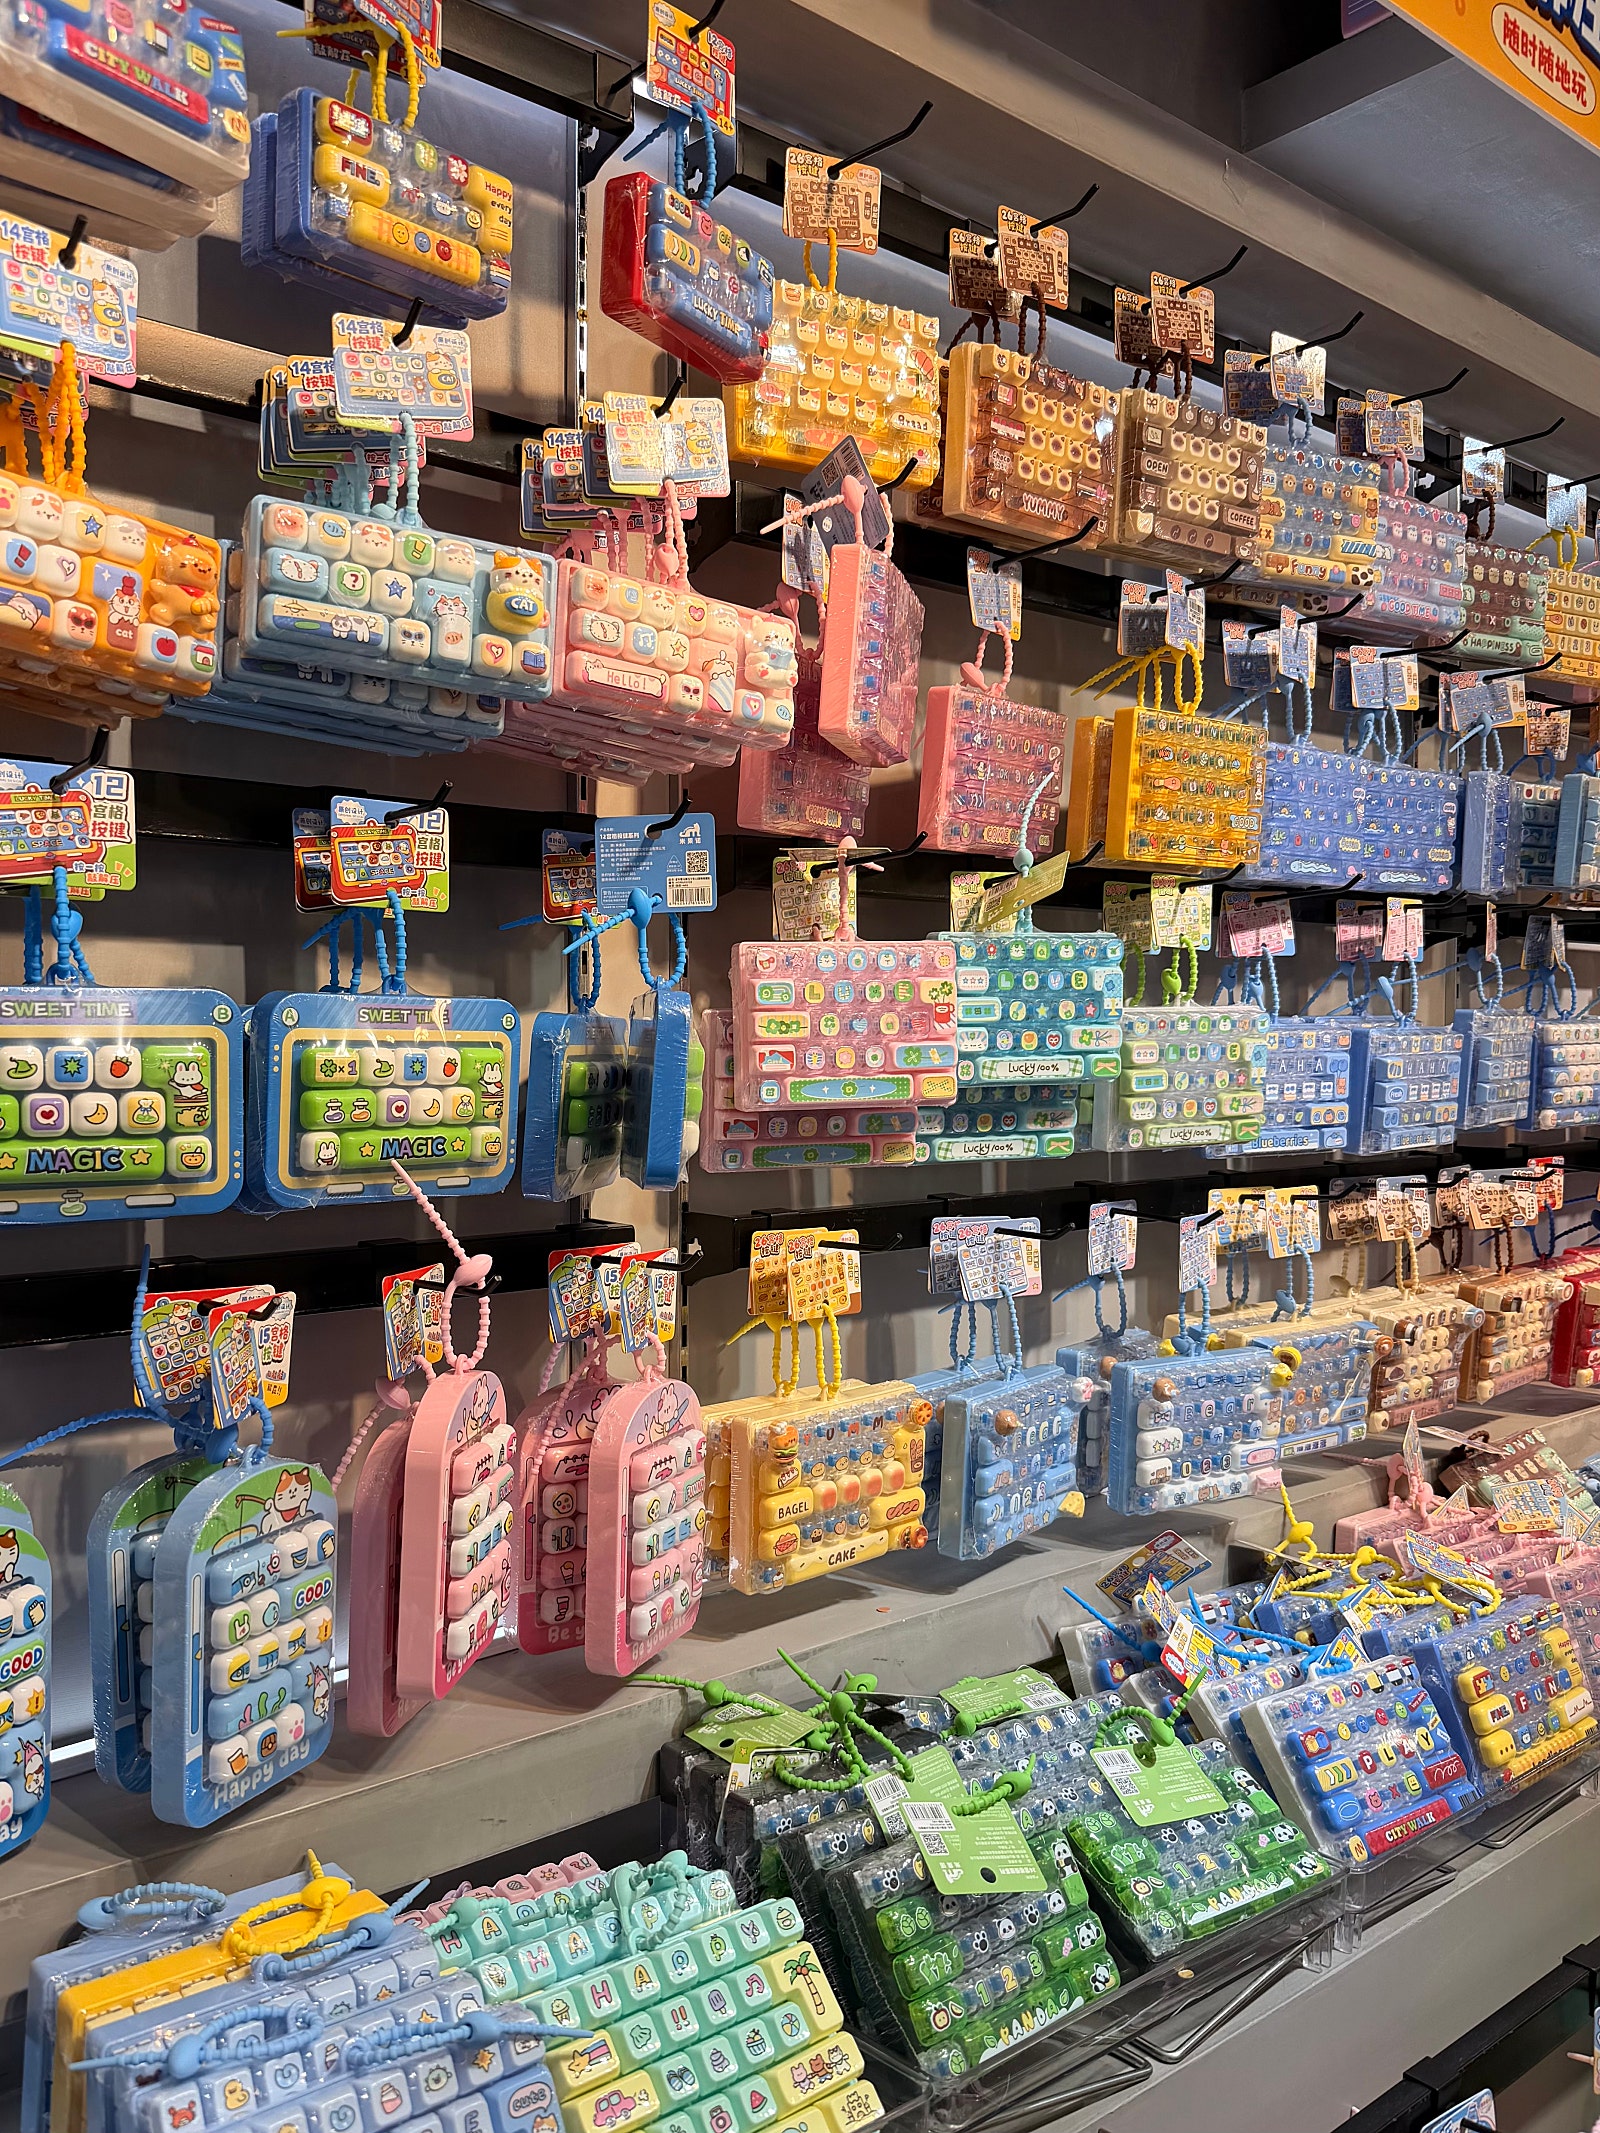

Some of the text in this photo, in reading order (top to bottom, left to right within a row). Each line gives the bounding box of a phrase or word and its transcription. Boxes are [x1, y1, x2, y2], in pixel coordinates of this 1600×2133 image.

[423, 46, 440, 64] 14+
[1503, 12, 1587, 107] 随时随地玩
[83, 41, 188, 106] CITY WALK
[718, 118, 733, 132] 14+
[789, 152, 823, 168] 26宫格
[797, 165, 819, 178] 按键
[485, 182, 512, 202] Happy
[491, 200, 512, 215] every
[498, 214, 512, 227] day
[1001, 209, 1027, 225] 26宫格
[1, 221, 50, 247] 14宫格
[952, 231, 981, 245] 26宫格
[14, 243, 49, 267] 按键
[106, 309, 121, 321] CAT
[693, 296, 739, 334] LUCKY TIME
[337, 319, 384, 336] 14宫格
[352, 337, 383, 350] 按键
[76, 357, 105, 373] 按一按
[442, 375, 454, 383] CAT
[620, 411, 647, 425] 按键
[898, 414, 928, 431] Bread
[415, 424, 442, 435] 按一按
[1147, 460, 1168, 473] OPEN
[675, 485, 700, 495] 按一按
[1022, 493, 1066, 521] YUMMY
[1230, 512, 1255, 526] COFFEE
[1290, 561, 1327, 579] Funny
[511, 597, 534, 612] CAT
[1389, 601, 1431, 620] GOOD TIME
[115, 627, 134, 640] cat
[1470, 635, 1514, 653] HAPPINESS
[607, 671, 646, 690] Hello!
[91, 774, 126, 798] 12
[92, 803, 124, 820] 宫格
[338, 806, 365, 816] 原创设计
[418, 812, 442, 831] 12
[1233, 816, 1257, 829] GOOD
[90, 821, 126, 841] 按键
[987, 826, 1008, 843] COME
[31, 838, 64, 849] SPACE
[417, 836, 442, 851] 宫格
[73, 861, 106, 873] 按一按
[415, 852, 443, 868] 按键
[86, 873, 121, 886] 敲解压
[402, 888, 426, 897] 按一按
[411, 897, 437, 908] 敲解压
[1, 1001, 132, 1018] SWEET TIME
[217, 1008, 229, 1020] B
[284, 1009, 295, 1021] A
[359, 1008, 411, 1024] SWEET
[505, 1017, 513, 1028] B
[1008, 1062, 1036, 1075] Lucky
[1169, 1128, 1192, 1141] Lucky
[1252, 1134, 1309, 1150] Blueberries
[381, 1137, 447, 1160] MAGIC
[963, 1143, 990, 1157] Lucky
[27, 1149, 125, 1174] MAGIC
[958, 1225, 989, 1239] 26宫格
[754, 1232, 785, 1249] 26宫格
[787, 1235, 815, 1253] 26宫格
[965, 1235, 986, 1247] 按键
[184, 1334, 206, 1348] GOOD
[259, 1323, 290, 1348] 15宫格
[262, 1344, 285, 1363] 按键
[778, 1501, 810, 1520] BAGEL
[828, 1547, 856, 1567] CAKE
[294, 1578, 333, 1611] GOOD
[548, 1624, 569, 1644] Be
[632, 1613, 688, 1660] Be yourself
[1558, 1640, 1572, 1650] Happy
[0, 1646, 44, 1681] GOOD
[446, 1664, 457, 1683] Be
[214, 1737, 311, 1810] Happy day
[1386, 1811, 1436, 1843] CITY WALK
[1172, 1843, 1242, 1882] 1 2 3
[975, 1951, 1044, 2008] 1 2 3
[1000, 2004, 1060, 2046] PANDA
[511, 2087, 548, 2113] cute
